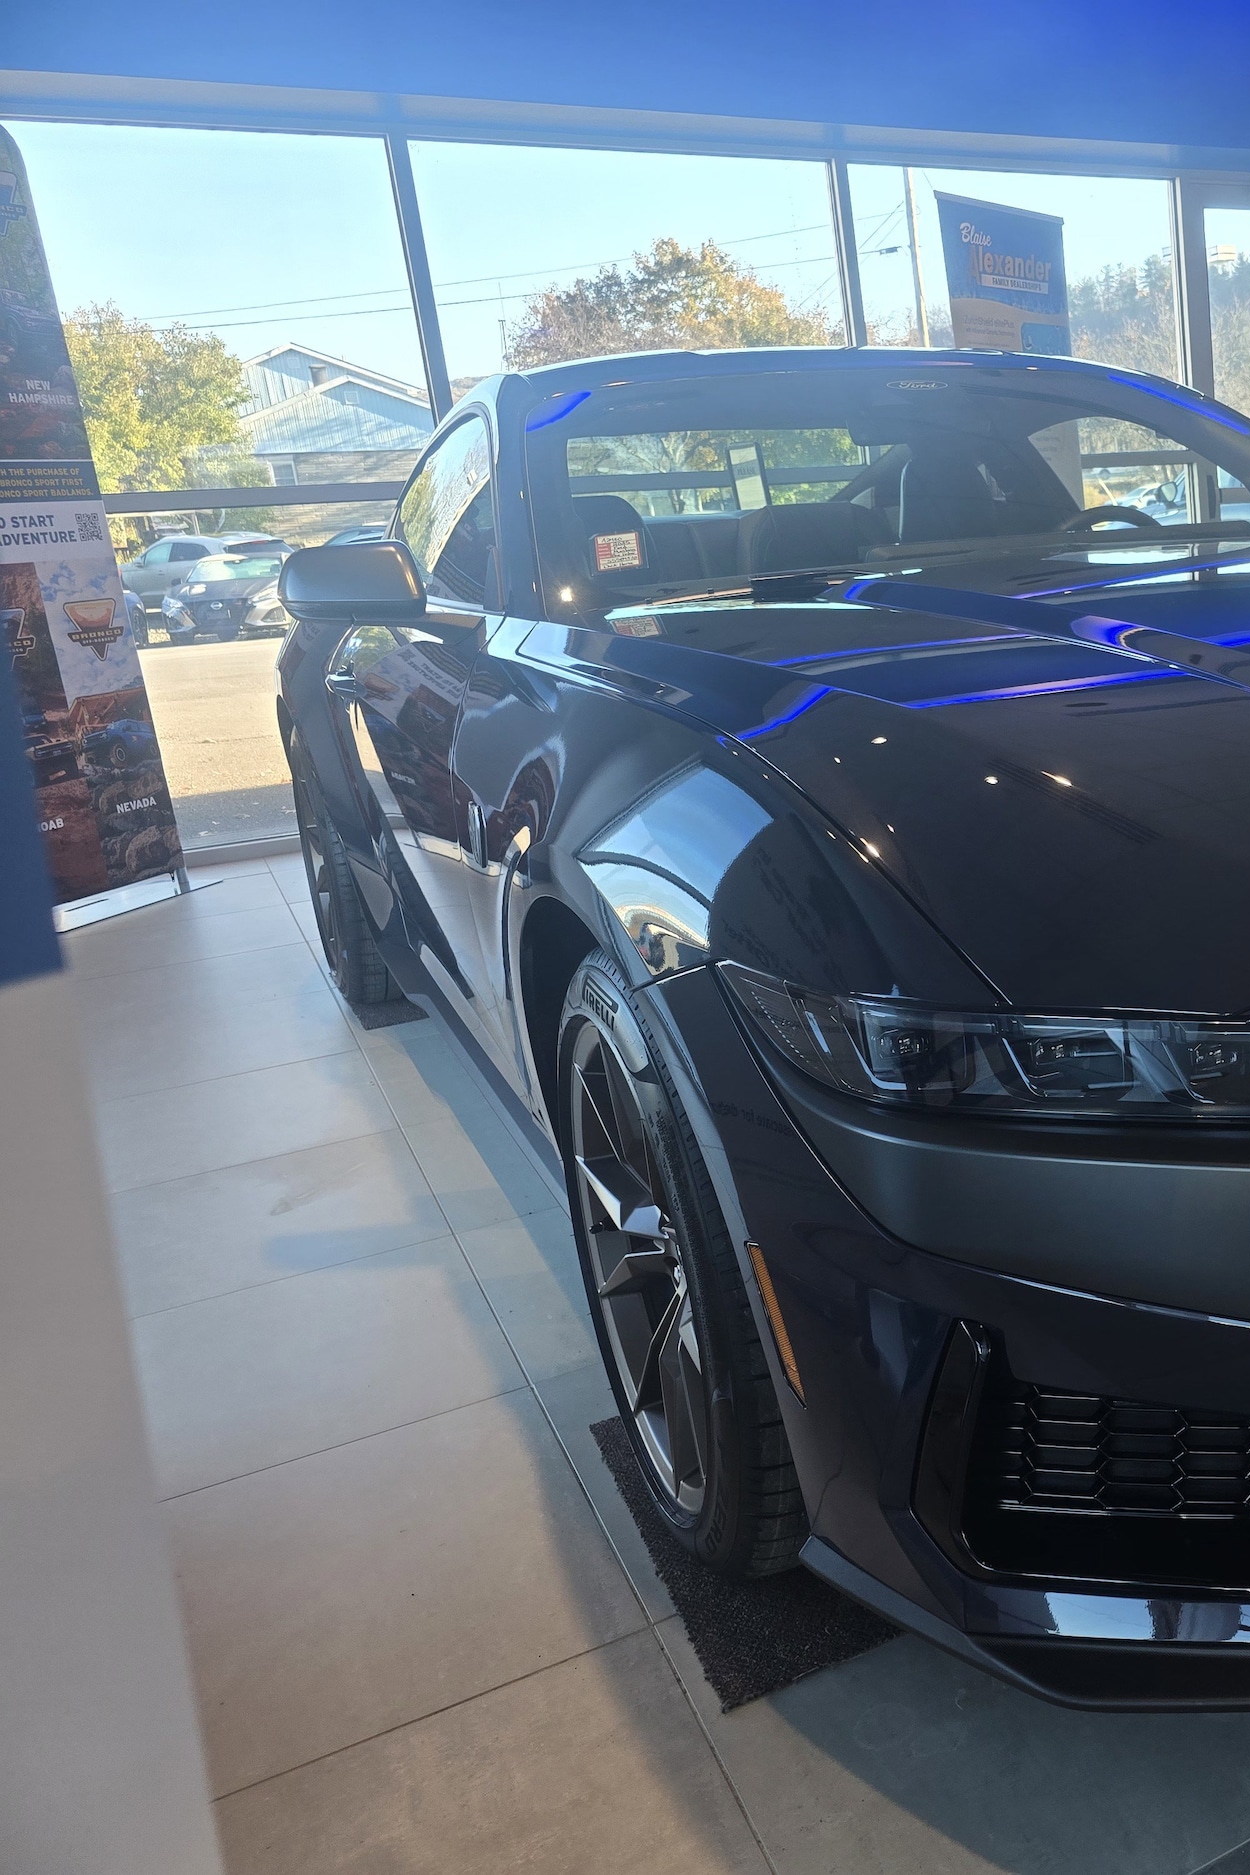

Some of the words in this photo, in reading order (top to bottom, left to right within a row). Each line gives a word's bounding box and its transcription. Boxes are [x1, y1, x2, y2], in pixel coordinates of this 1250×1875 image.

[959, 222, 992, 247] Blaise
[968, 245, 1052, 286] Alexander
[992, 277, 1010, 288] FAMILY
[25, 380, 51, 391] NEW
[8, 392, 75, 405] HAMPSHIRE
[8, 468, 26, 476] THE
[27, 468, 69, 476] PURCHASE
[70, 467, 80, 475] OF
[0, 479, 33, 487] BRONCO
[34, 478, 60, 486] SPORT
[61, 478, 83, 486] FIRST
[23, 489, 49, 497] SPORT
[50, 488, 94, 497] BADLANDS.
[10, 514, 54, 529] START
[72, 629, 121, 640] BRONCO
[115, 796, 157, 814] NEVADA
[582, 974, 620, 1033] PIRELLI
